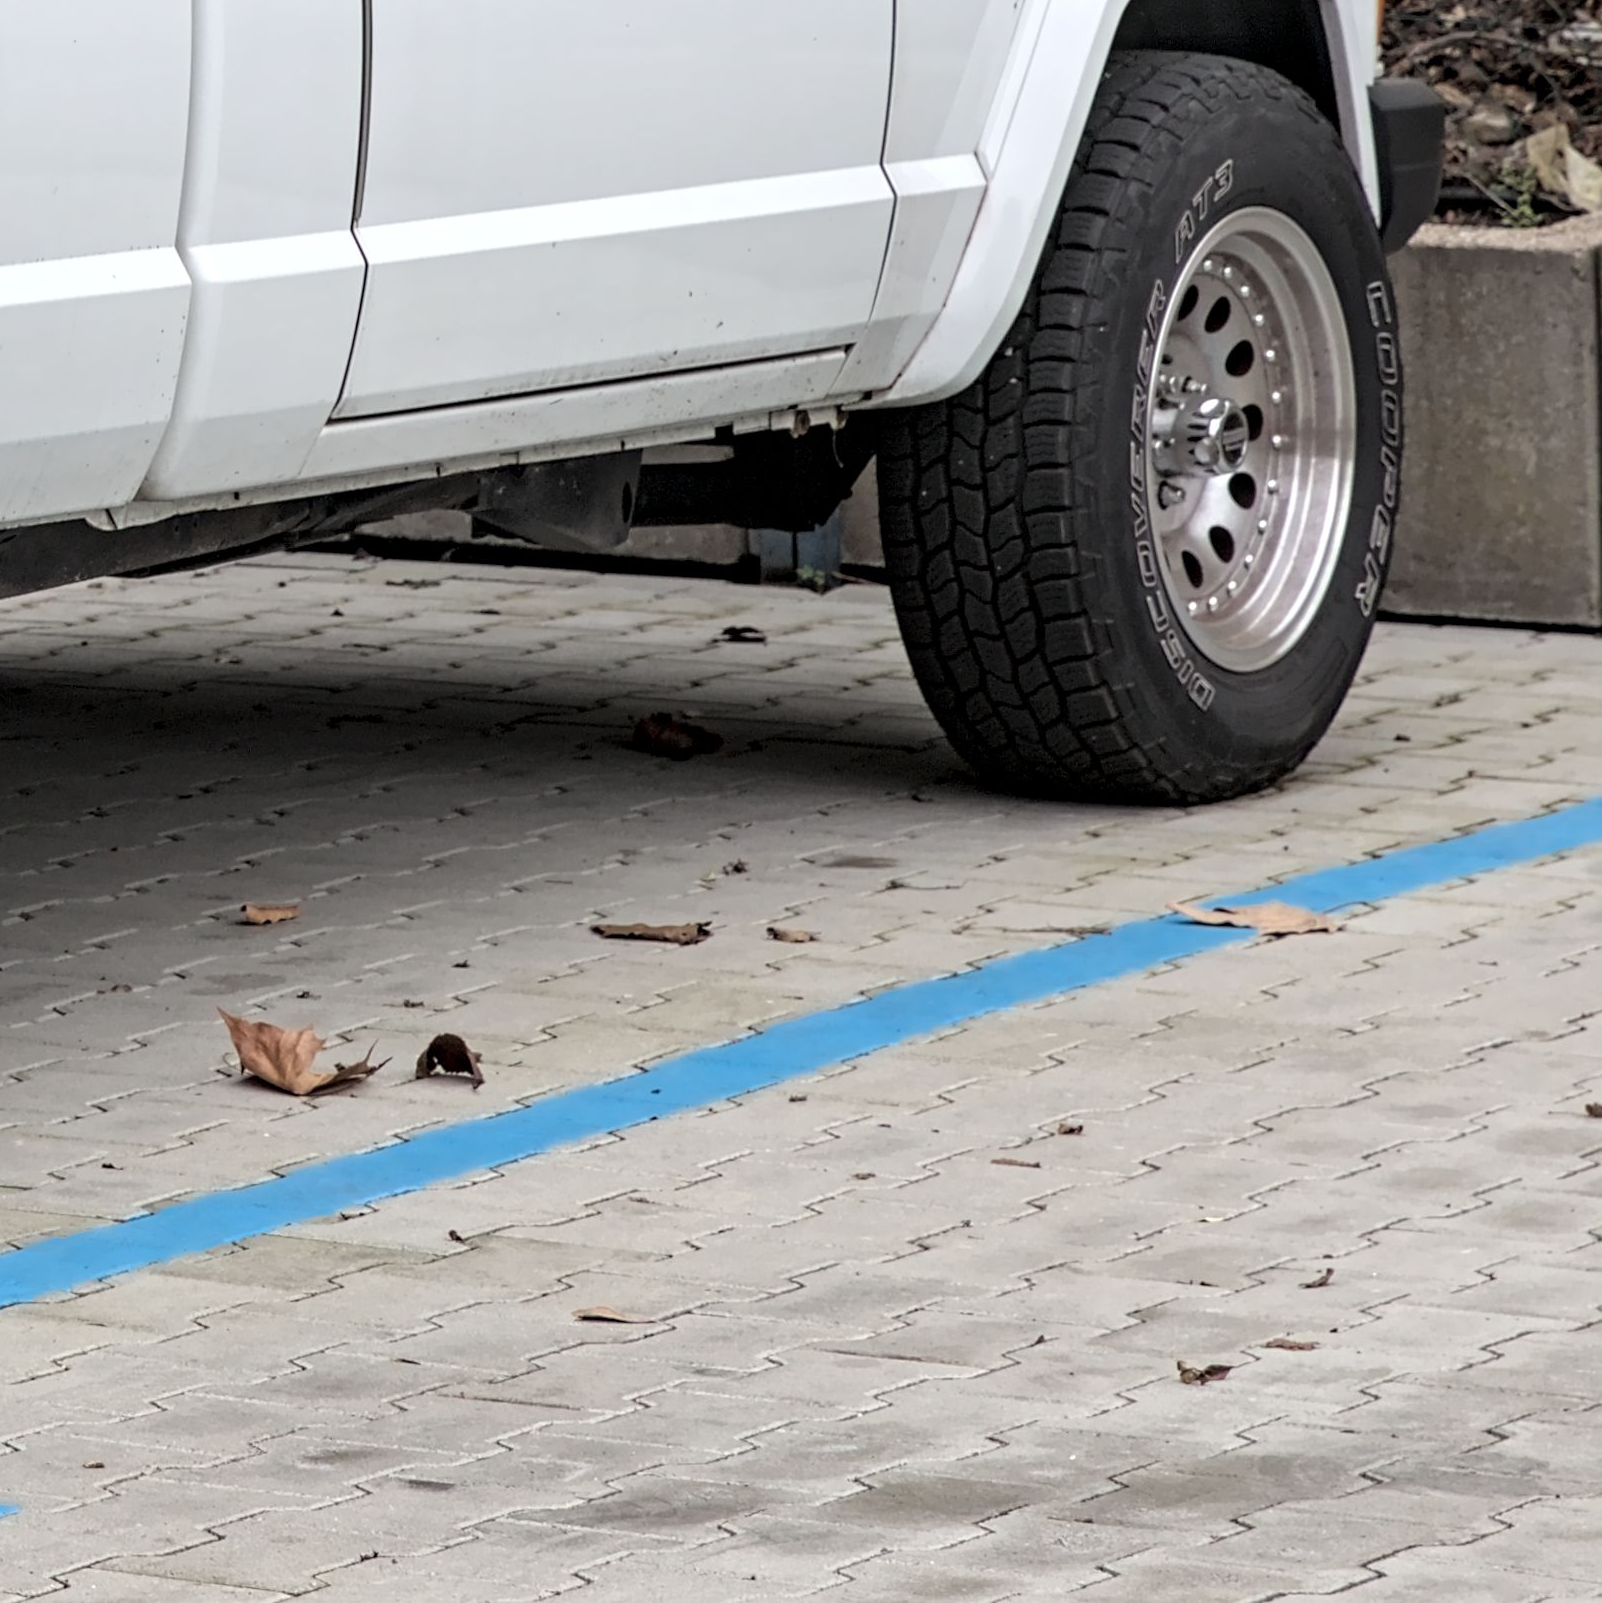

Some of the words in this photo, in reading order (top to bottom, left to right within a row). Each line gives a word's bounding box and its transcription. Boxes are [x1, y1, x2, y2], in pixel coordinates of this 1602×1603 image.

[1128, 278, 1216, 712] DISCOVERER
[1173, 159, 1235, 265] AT3
[1354, 281, 1399, 618] COOPER
